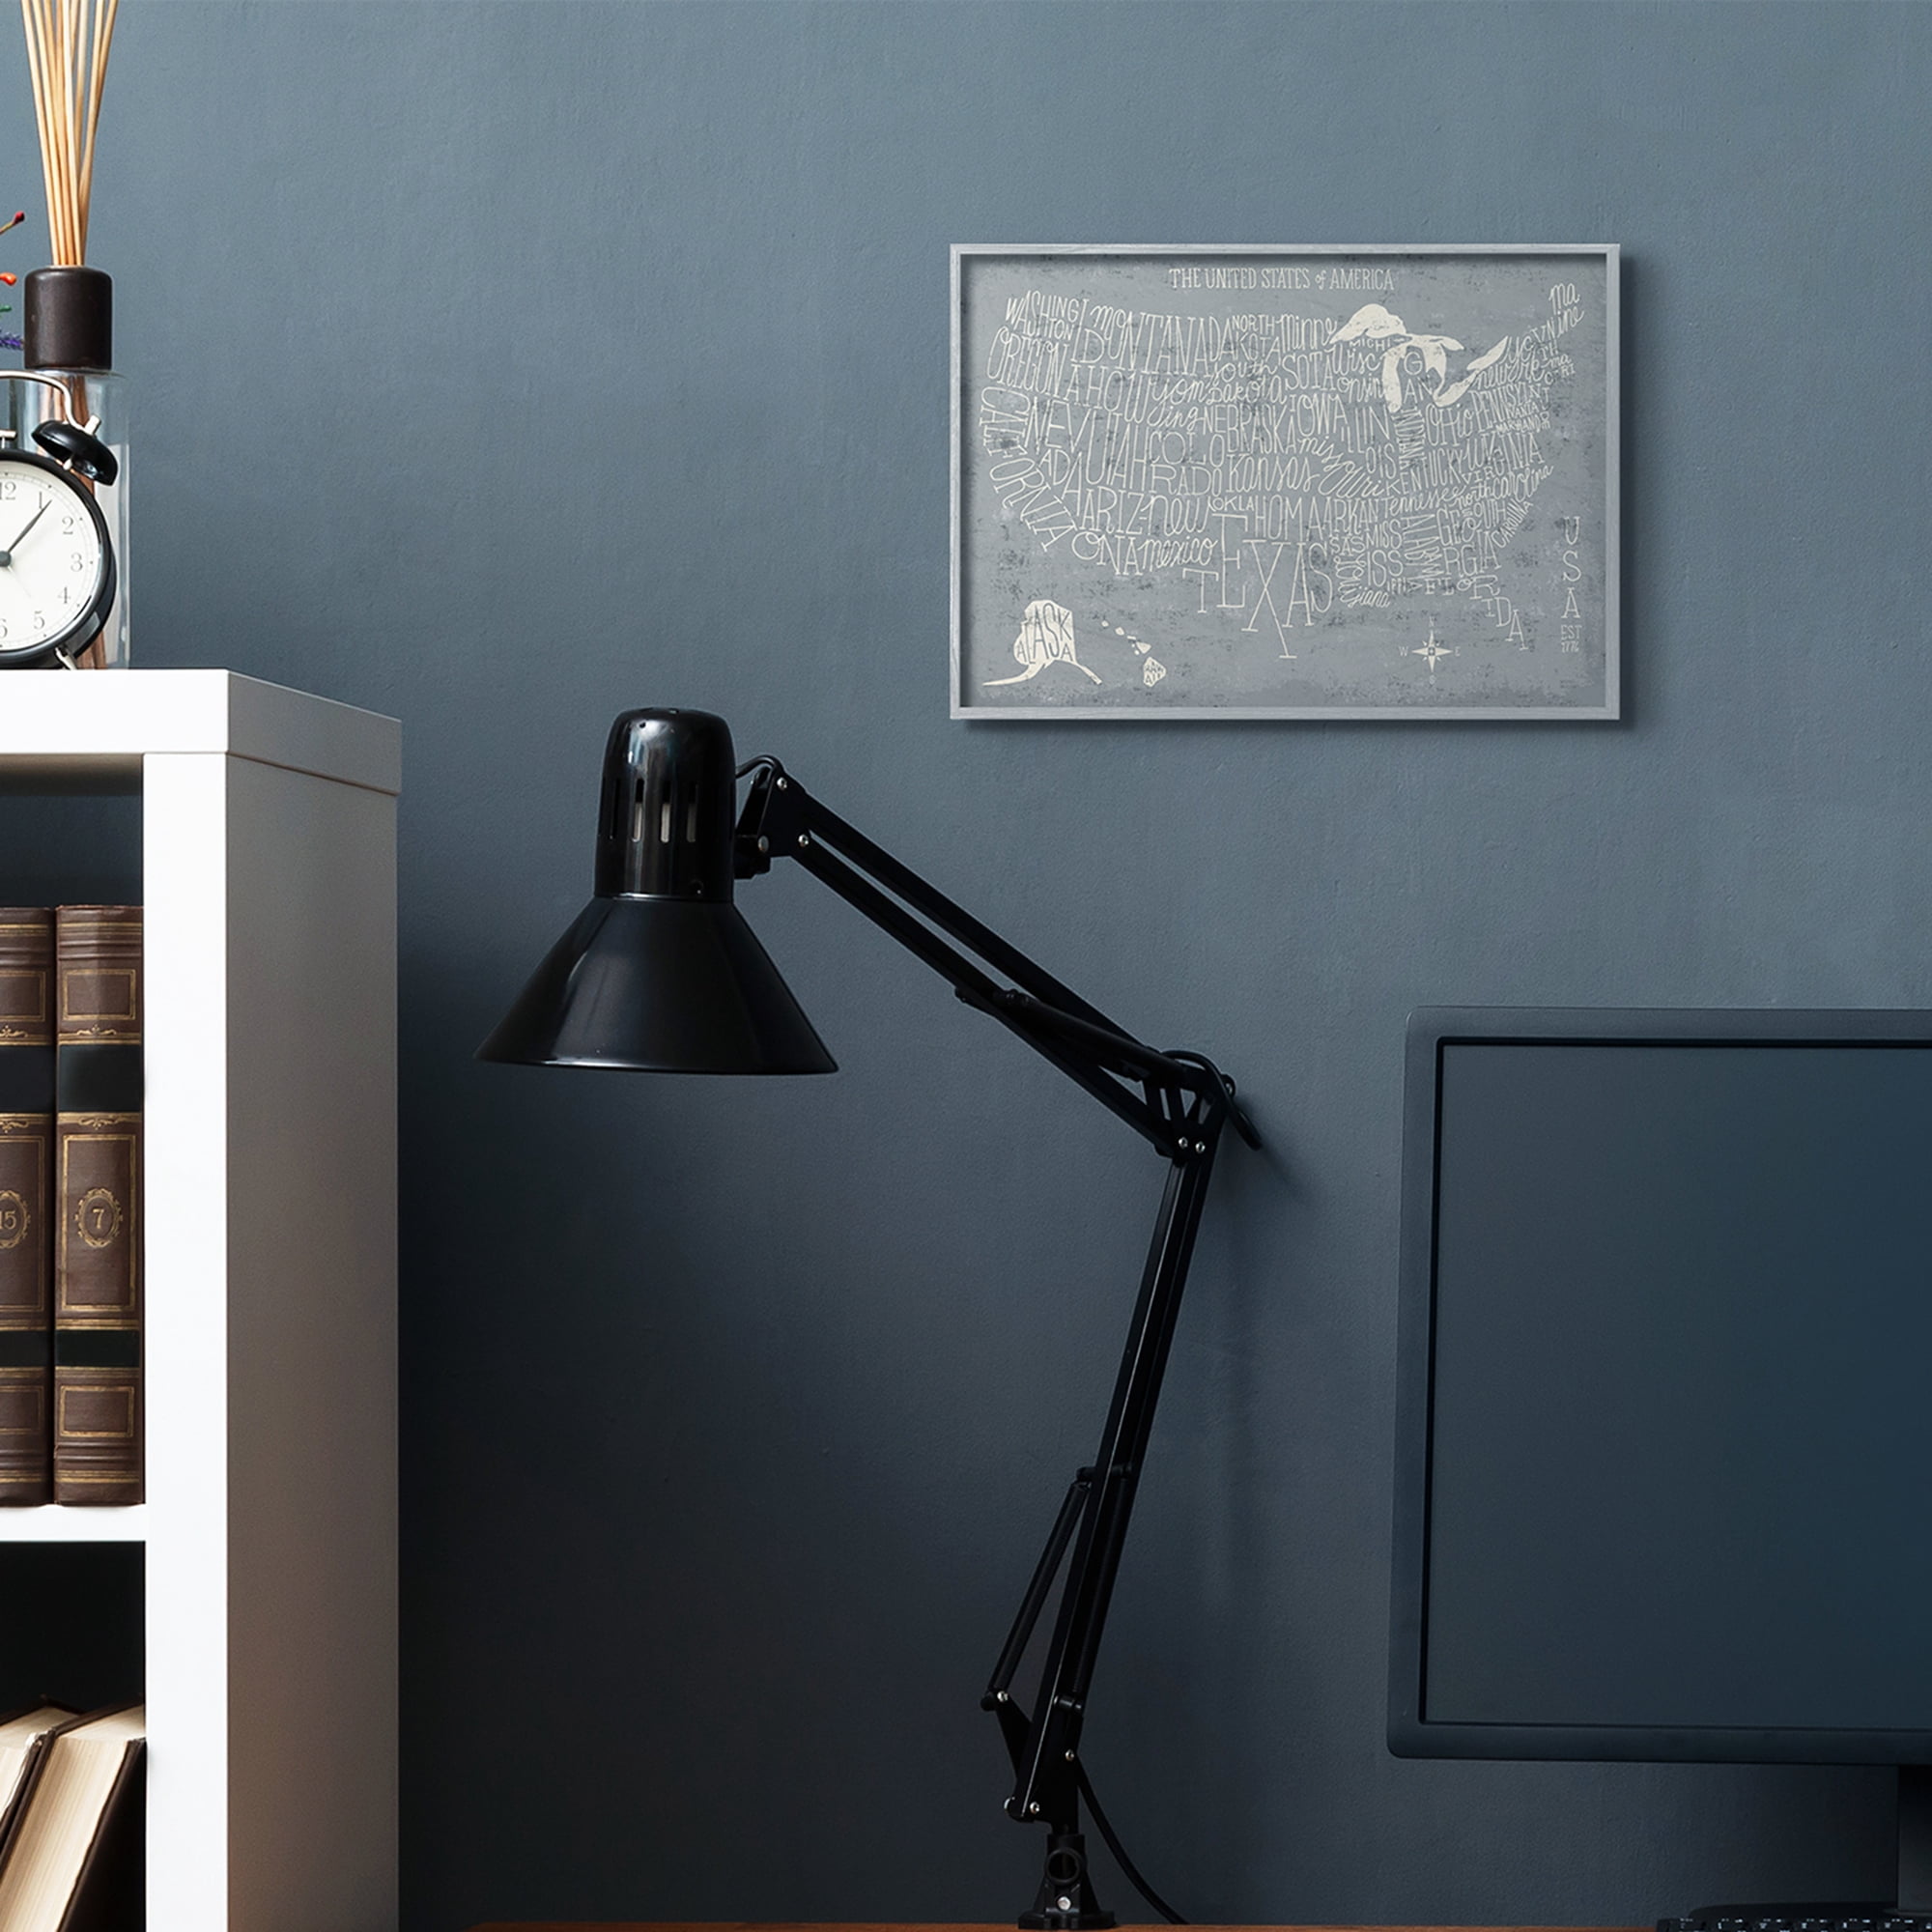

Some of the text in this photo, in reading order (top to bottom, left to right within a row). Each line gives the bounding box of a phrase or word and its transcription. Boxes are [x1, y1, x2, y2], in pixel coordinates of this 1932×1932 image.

[1169, 268, 1394, 290] THE UNITED STATES of AMERICA
[1232, 314, 1275, 335] NORTH
[986, 326, 1070, 400] OREGON
[1289, 392, 1349, 438] IOWA
[1202, 404, 1297, 455] NEBRASKA
[1086, 410, 1150, 494] UTAH
[62, 516, 74, 535] 2
[71, 553, 83, 572] 3
[58, 586, 71, 604] 4
[1182, 512, 1333, 659] TEXAS
[33, 610, 45, 630] 5
[1424, 574, 1529, 650] FLORIDA
[1016, 603, 1074, 665] ALASKA
[1561, 624, 1582, 640] EST
[92, 1208, 105, 1230] 7
